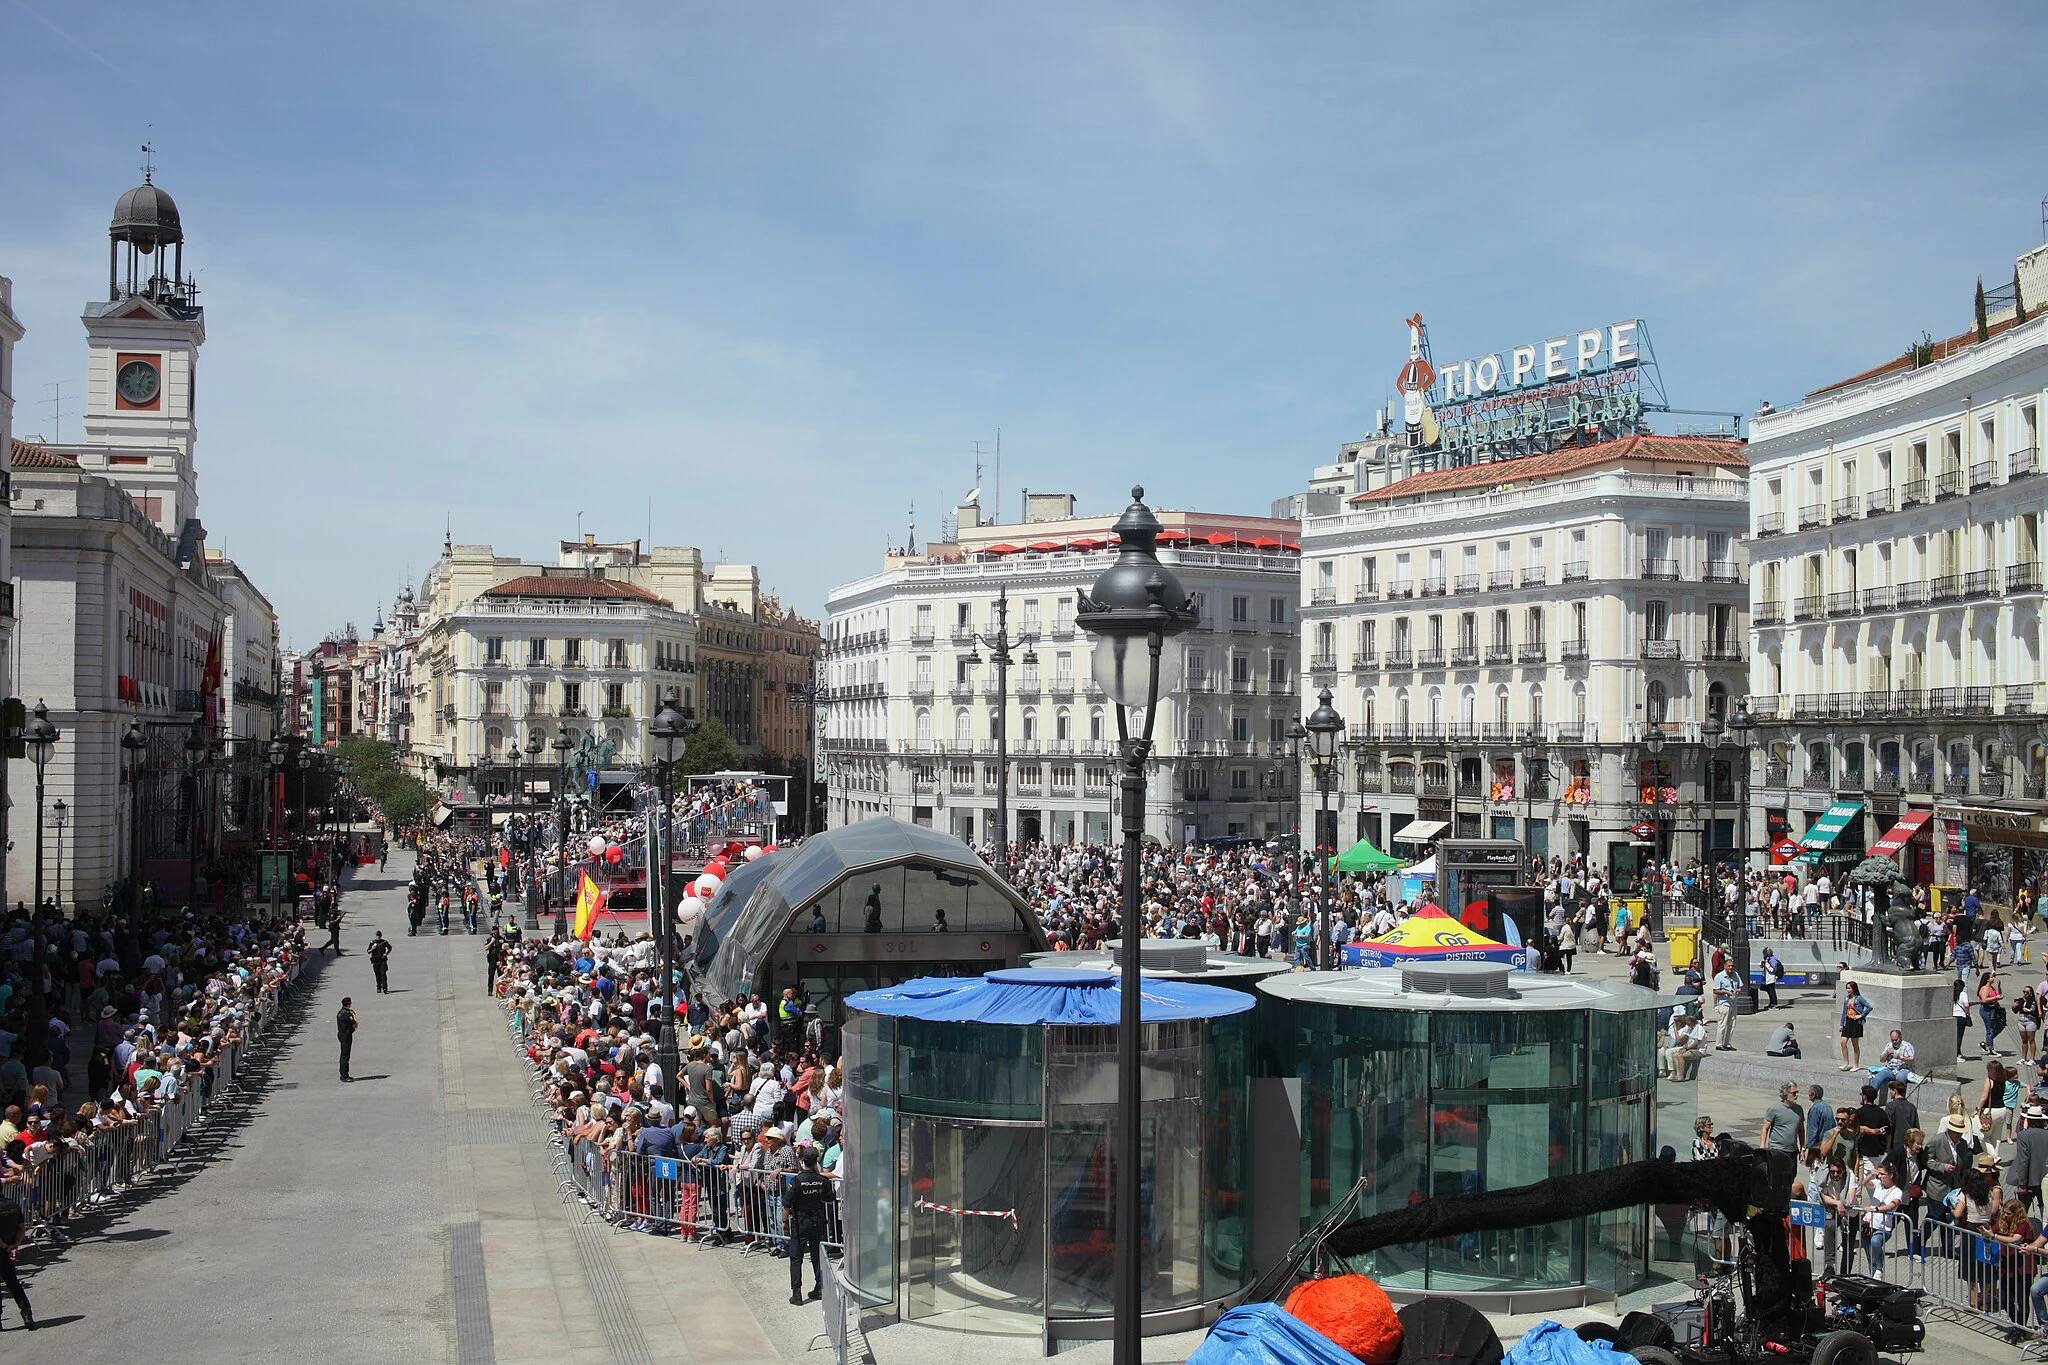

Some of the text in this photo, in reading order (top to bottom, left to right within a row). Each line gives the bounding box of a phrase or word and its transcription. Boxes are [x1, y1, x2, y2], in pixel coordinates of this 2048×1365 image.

[1440, 319, 1636, 400] TIO PEPE
[1568, 390, 1639, 428] BYASS
[816, 712, 827, 774] MODERNO
[1828, 806, 1858, 817] CHANGE
[1894, 821, 1922, 831] CHANGE
[1995, 815, 2006, 829] DE
[1824, 854, 1858, 863] CHANGE
[886, 942, 918, 953] SOL
[1446, 951, 1486, 961] DISTRITO
